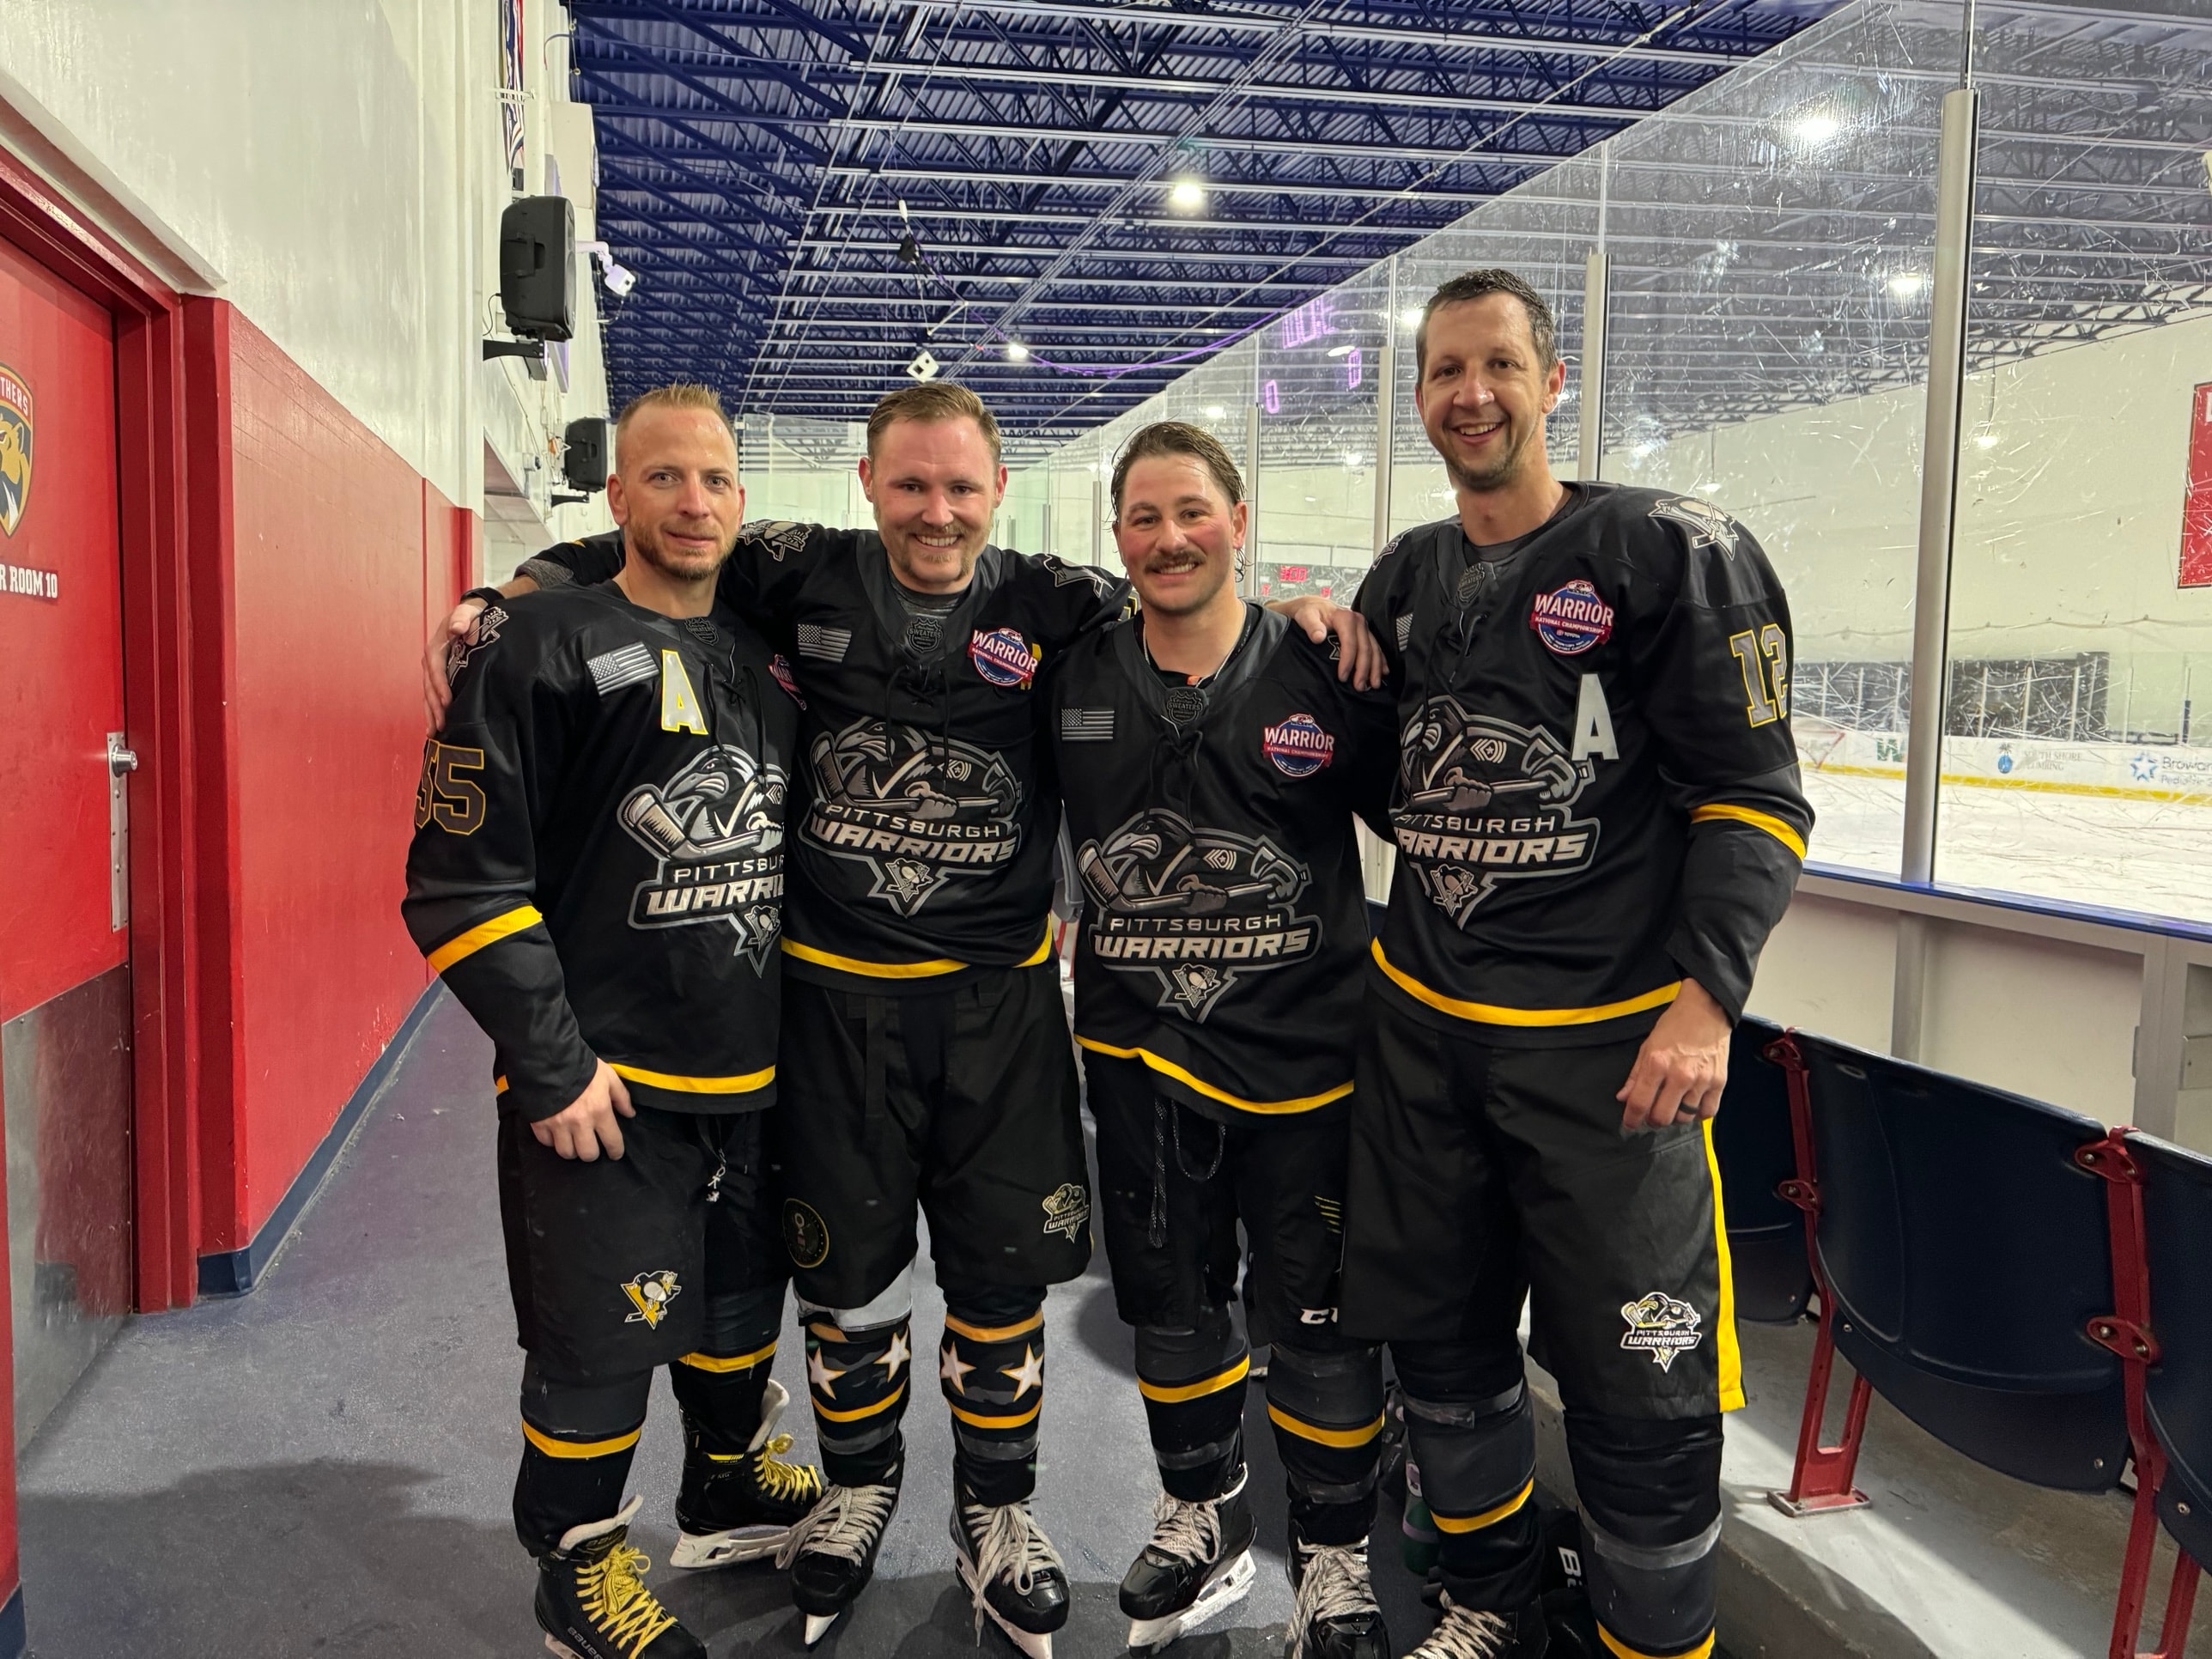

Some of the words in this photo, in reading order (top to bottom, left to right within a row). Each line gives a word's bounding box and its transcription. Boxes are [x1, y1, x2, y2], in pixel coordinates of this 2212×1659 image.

[9, 565, 44, 597] ROOM
[46, 573, 58, 599] 10
[1534, 594, 1614, 626] WARRIOR
[1534, 617, 1560, 626] NATIONAL
[972, 629, 1038, 673] WARRIOR
[661, 649, 708, 735] A
[1729, 623, 1788, 728] 12
[1571, 673, 1620, 761] A
[1264, 727, 1334, 751] WARRIOR
[825, 805, 1000, 838] PITTSBURGH
[1395, 815, 1556, 834] PITTSBURGH
[811, 816, 1017, 864] WARRIORS
[1394, 827, 1589, 865] ARRIORS
[1109, 913, 1281, 932] PITTSBURGH
[1094, 928, 1311, 959] WARRIORS
[1627, 1336, 1698, 1346] WARRIORS
